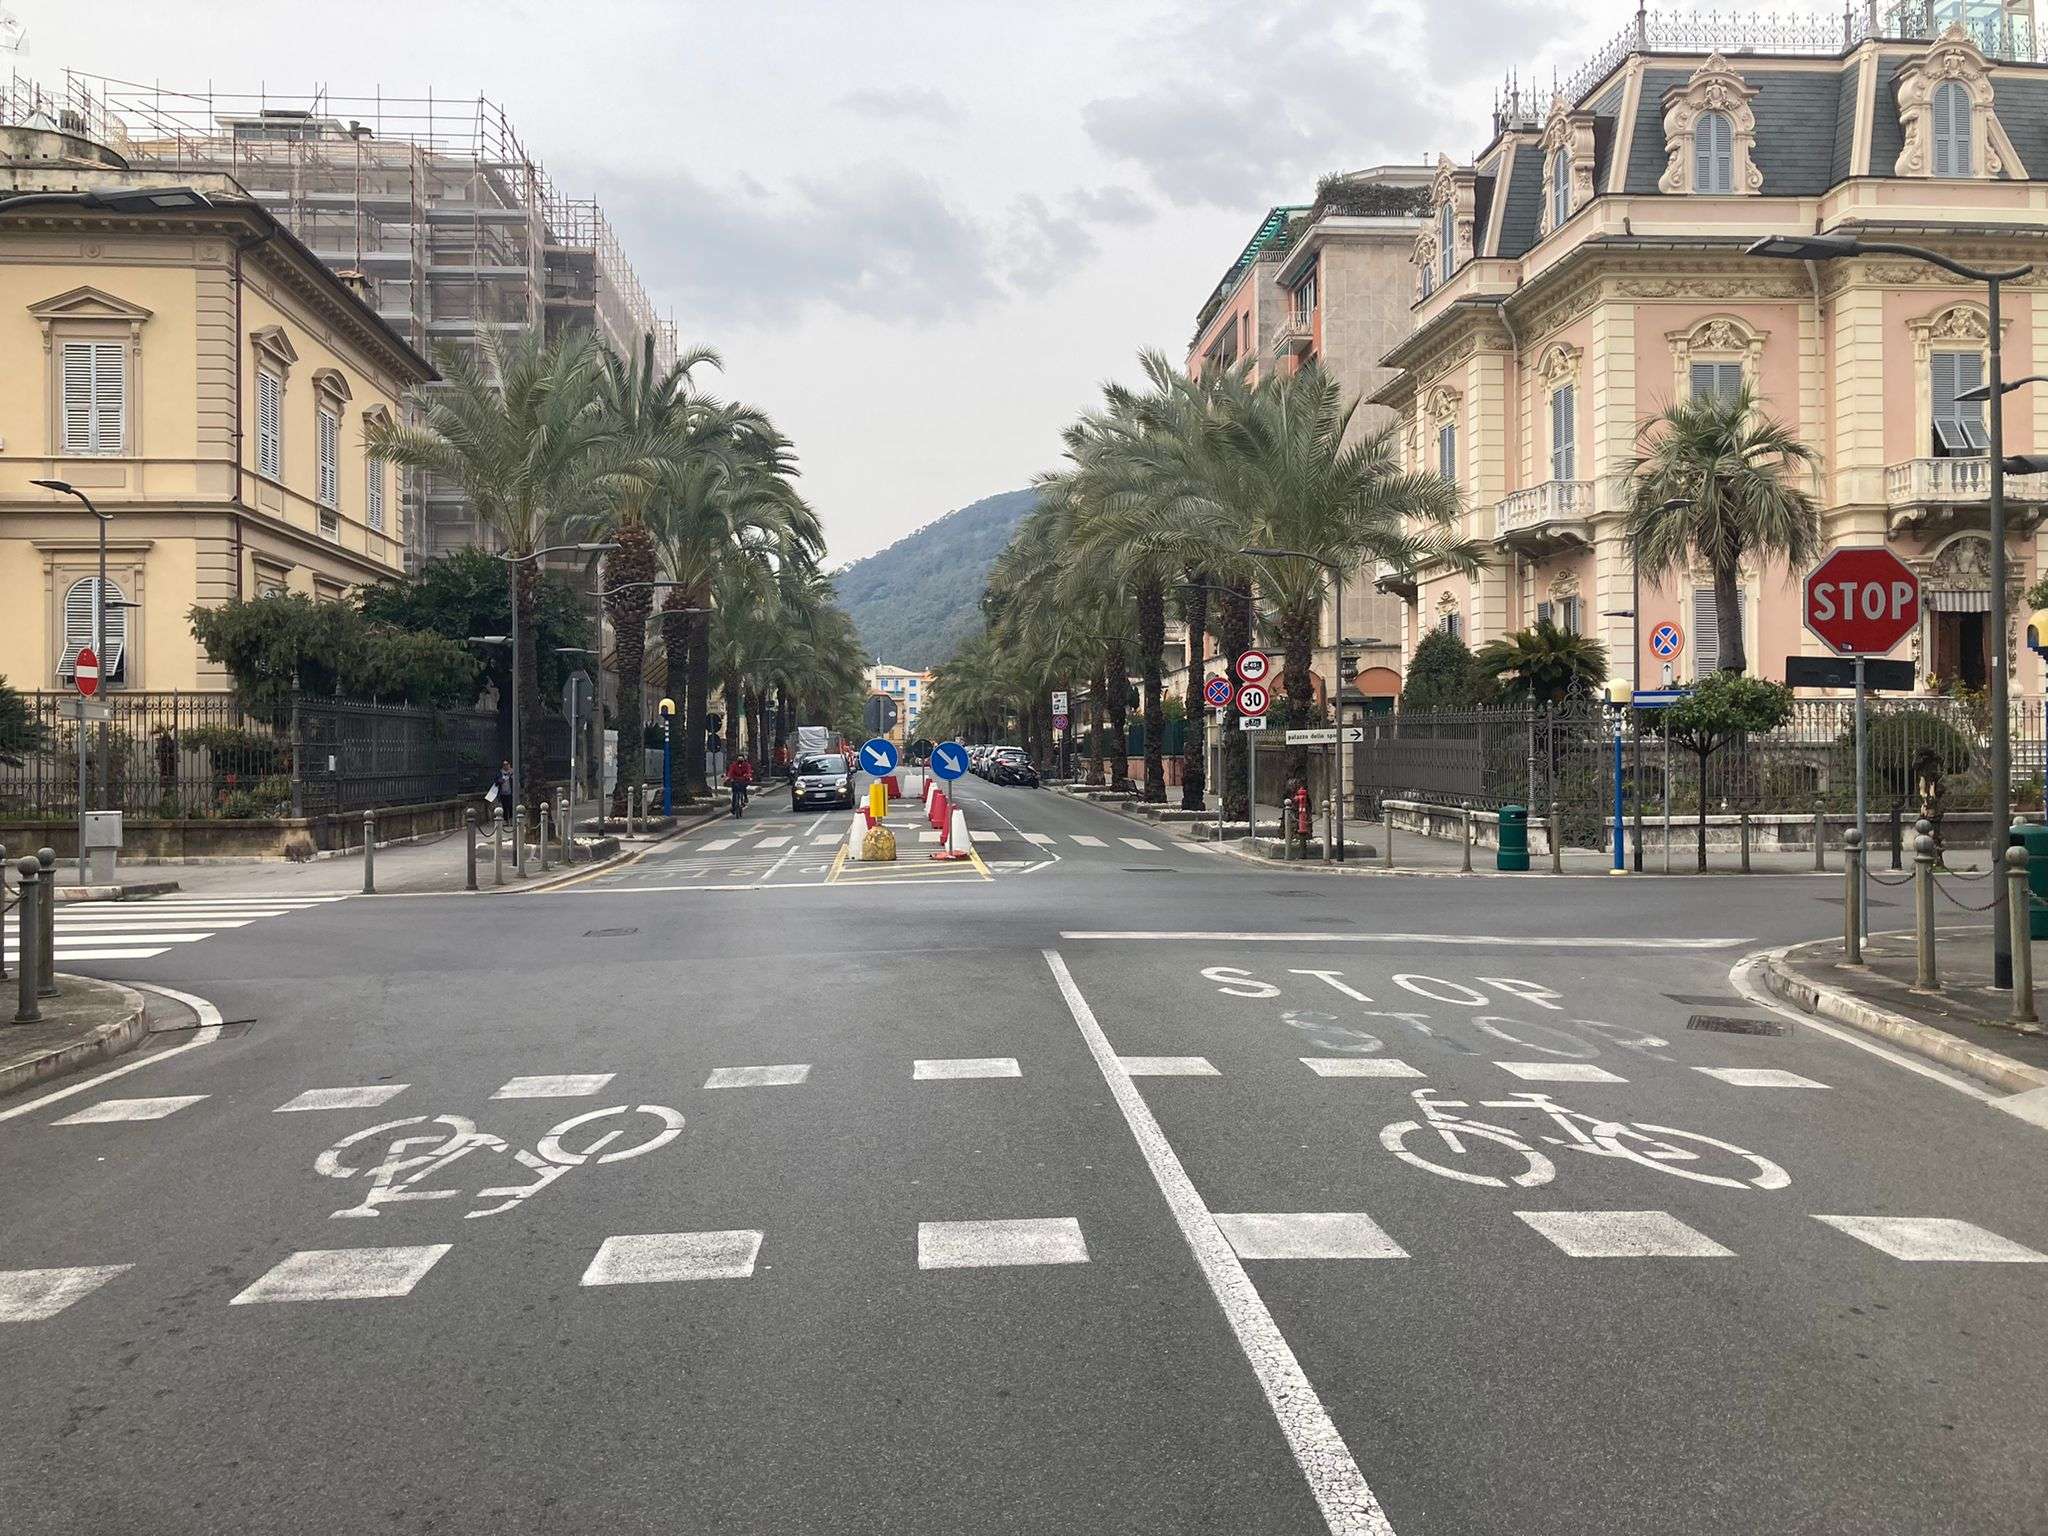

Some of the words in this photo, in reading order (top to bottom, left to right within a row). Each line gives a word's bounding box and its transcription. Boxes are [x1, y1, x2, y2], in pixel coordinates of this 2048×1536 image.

[1813, 581, 1914, 621] STOP
[1244, 692, 1262, 707] 30
[1200, 966, 1565, 1010] STOP
